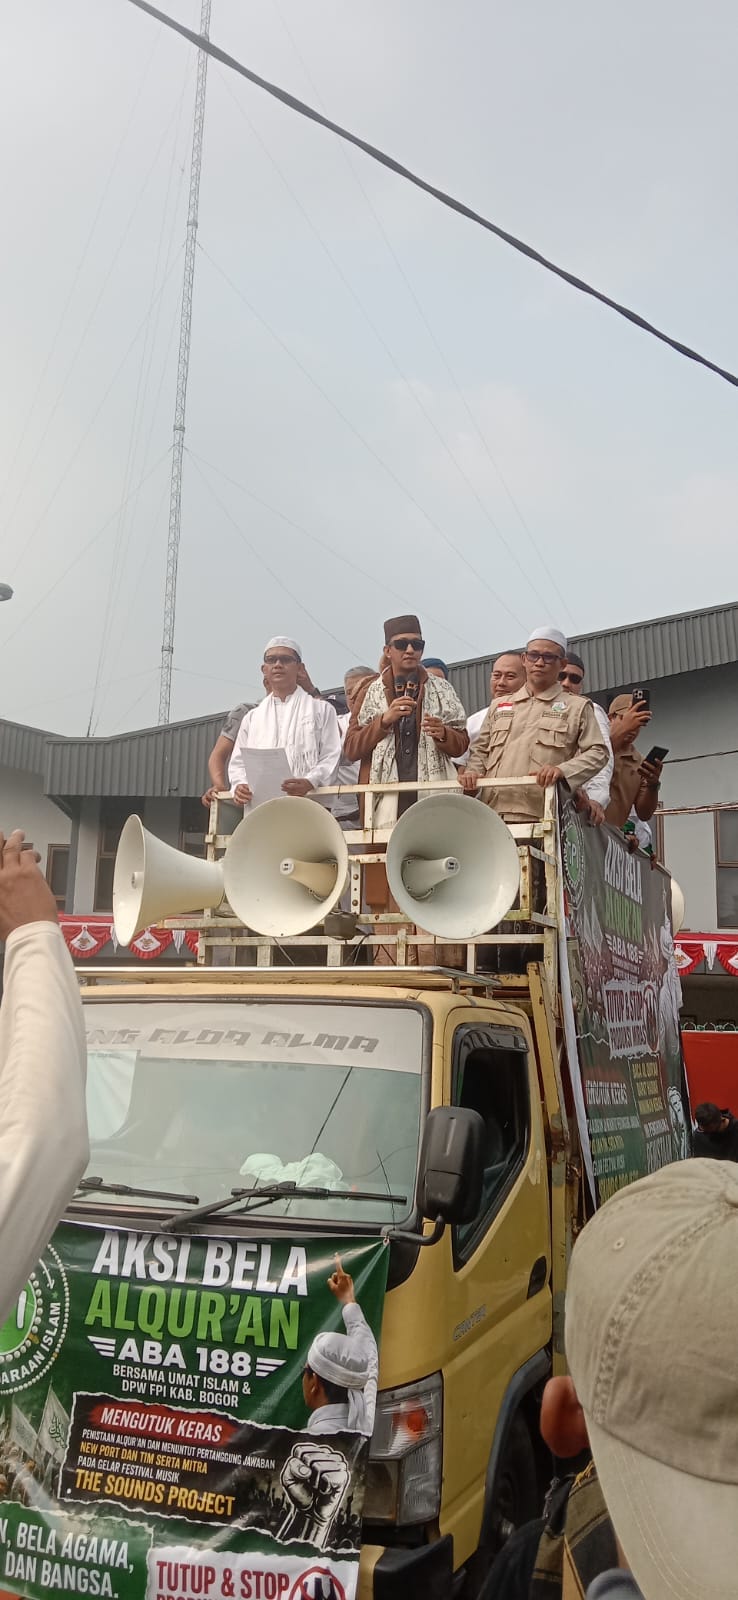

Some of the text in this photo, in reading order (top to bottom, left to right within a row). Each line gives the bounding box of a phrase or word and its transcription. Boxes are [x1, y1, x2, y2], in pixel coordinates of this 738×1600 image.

[604, 835, 625, 893] AKSI
[625, 850, 643, 905] BELA
[612, 935, 627, 959] ABA
[605, 989, 625, 1023] TUTUP
[91, 1230, 191, 1283] AKSI
[202, 1239, 308, 1296] BELA
[84, 1279, 299, 1350] ALQUR'AN
[0, 1350, 45, 1385] ARAAN
[40, 1302, 61, 1351] ISLAM
[118, 1338, 251, 1377] ABA 188
[113, 1364, 251, 1395] BERSAMA UMAT ISLAM &
[122, 1379, 239, 1408] DPW FPI KAB. BOGOR
[100, 1407, 222, 1442] MENGUTUK KERAS
[77, 1455, 180, 1483] PADA GELAR FESTIVAL MUSIK
[80, 1441, 208, 1474] NEW PORT DAN TIM SERTA MITRA
[82, 1429, 115, 1444] PENISTAAN
[147, 1438, 161, 1450] DAN
[161, 1442, 197, 1457] MENUNTUT
[196, 1448, 242, 1465] PERTANGGUNG
[242, 1454, 276, 1470] JAWABAN
[74, 1468, 236, 1516] THE SOUNDS PROJECT
[16, 1522, 57, 1556] BELA
[61, 1532, 134, 1574] AGAMA,
[5, 1551, 119, 1598] DAN BANGSA.
[156, 1561, 290, 1600] TUTUP & STOP
